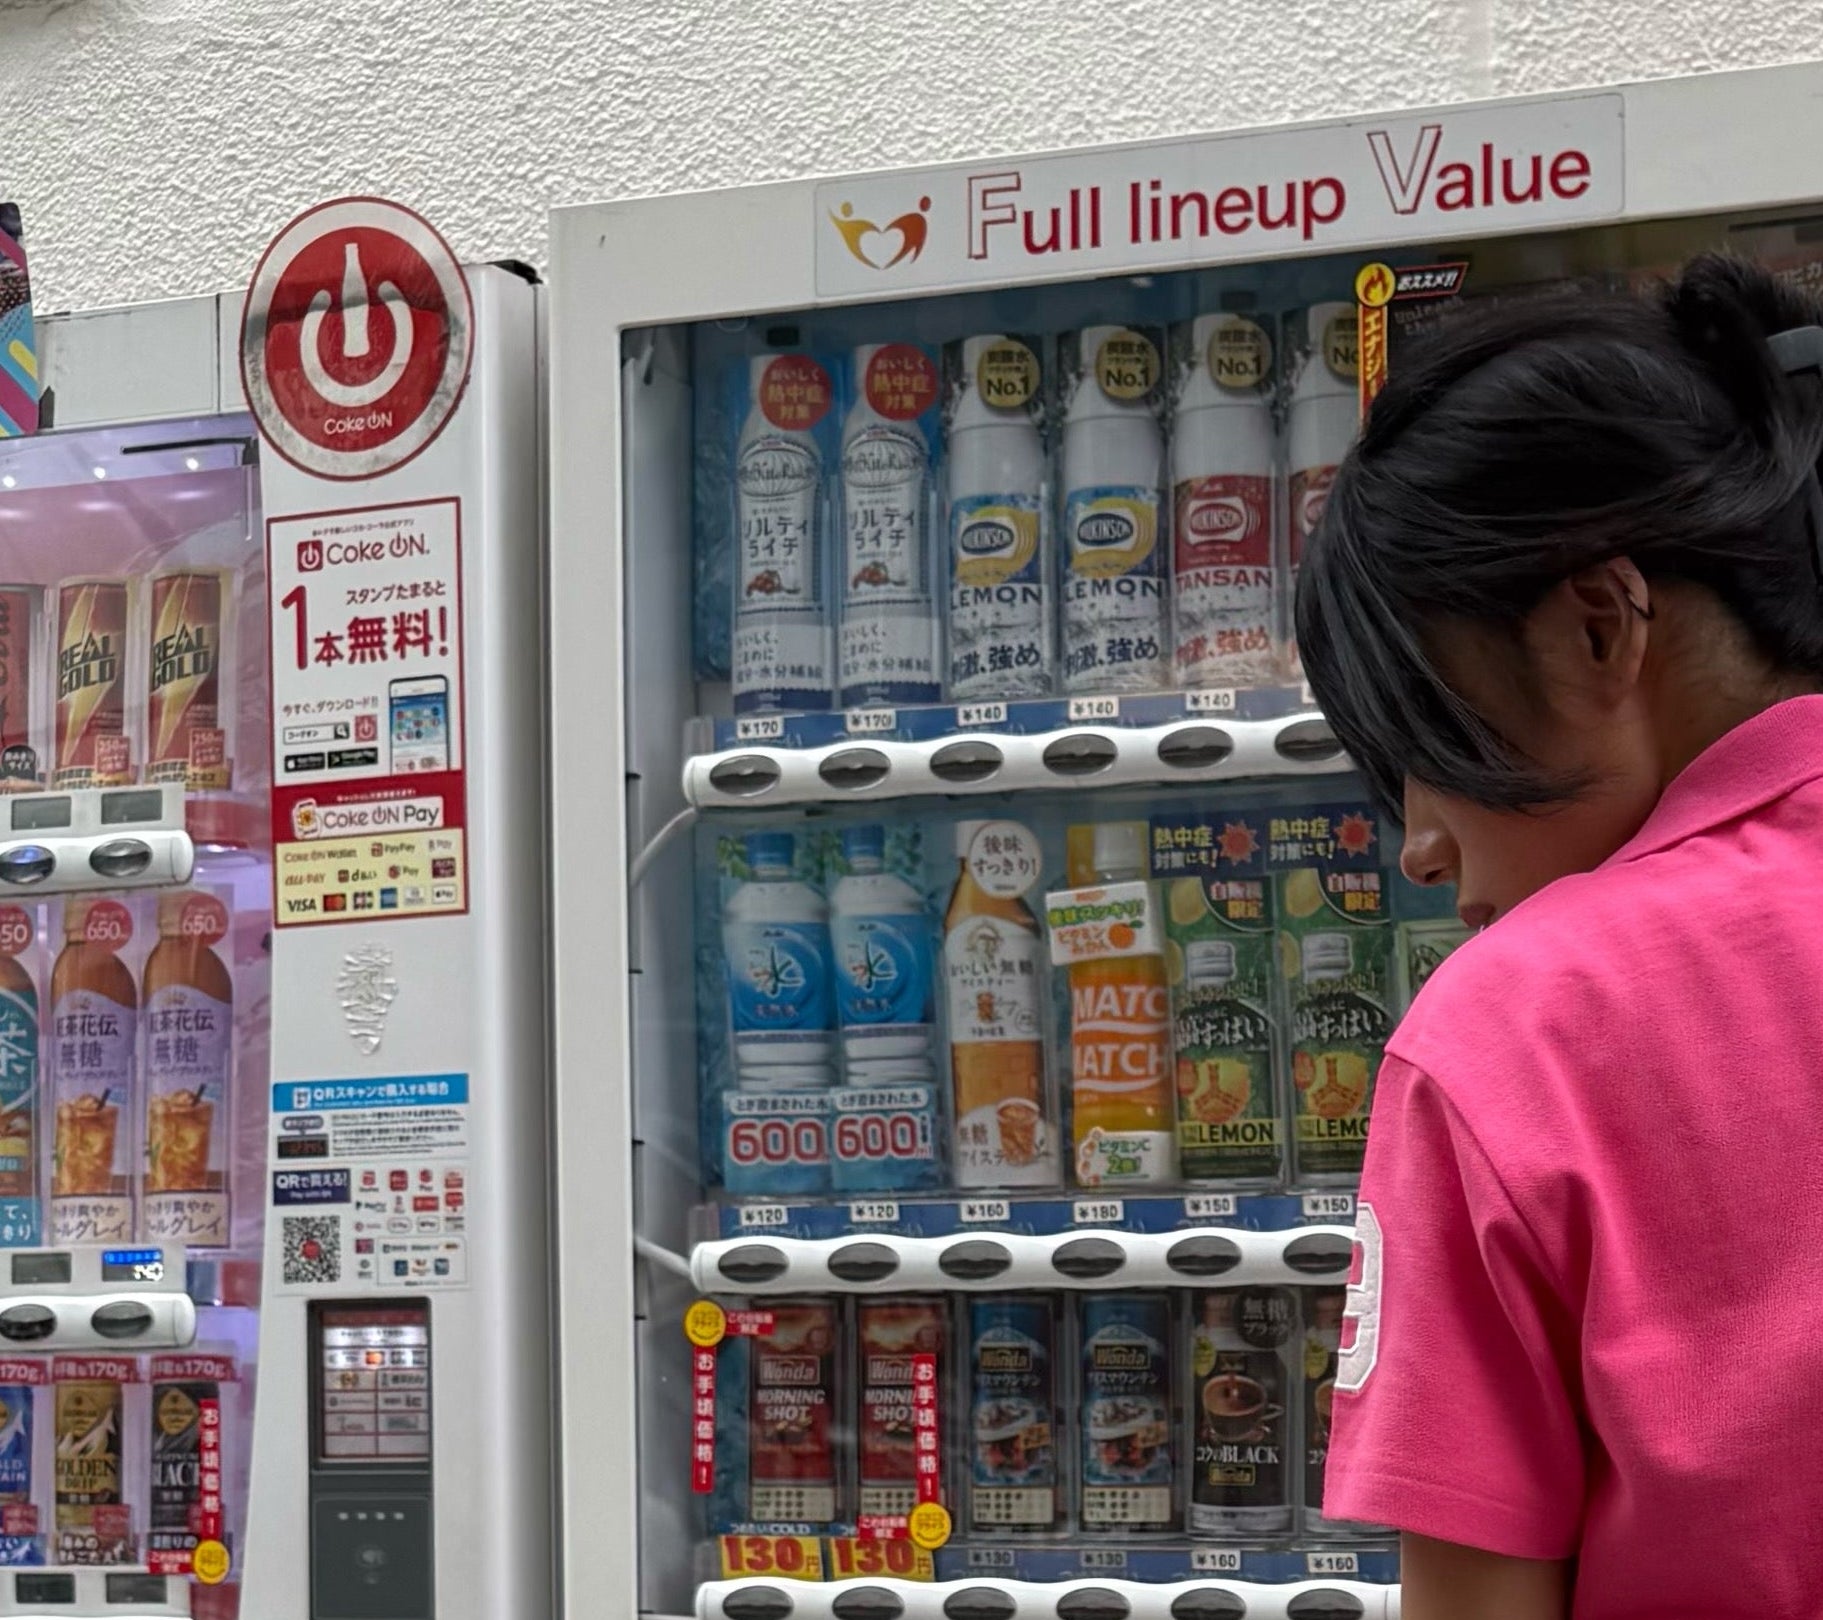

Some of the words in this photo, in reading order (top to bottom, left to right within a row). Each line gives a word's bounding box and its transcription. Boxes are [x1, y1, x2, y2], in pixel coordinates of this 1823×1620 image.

[967, 172, 1100, 259] Full
[1129, 176, 1344, 245] lineup
[1368, 125, 1592, 214] Value
[1218, 354, 1262, 377] No.1
[986, 377, 1030, 397] No.1
[1106, 367, 1150, 389] No.1
[327, 541, 385, 565] Coke
[1065, 577, 1163, 599] LEMON
[1176, 569, 1271, 589] TANSAN
[950, 586, 1042, 610] LEMON
[325, 806, 368, 830] Coke
[403, 804, 440, 828] Pay
[1072, 985, 1166, 1019] MATC
[1198, 1121, 1274, 1143] LEMON
[757, 1389, 825, 1404] MORNING
[764, 1405, 810, 1421] SHOT
